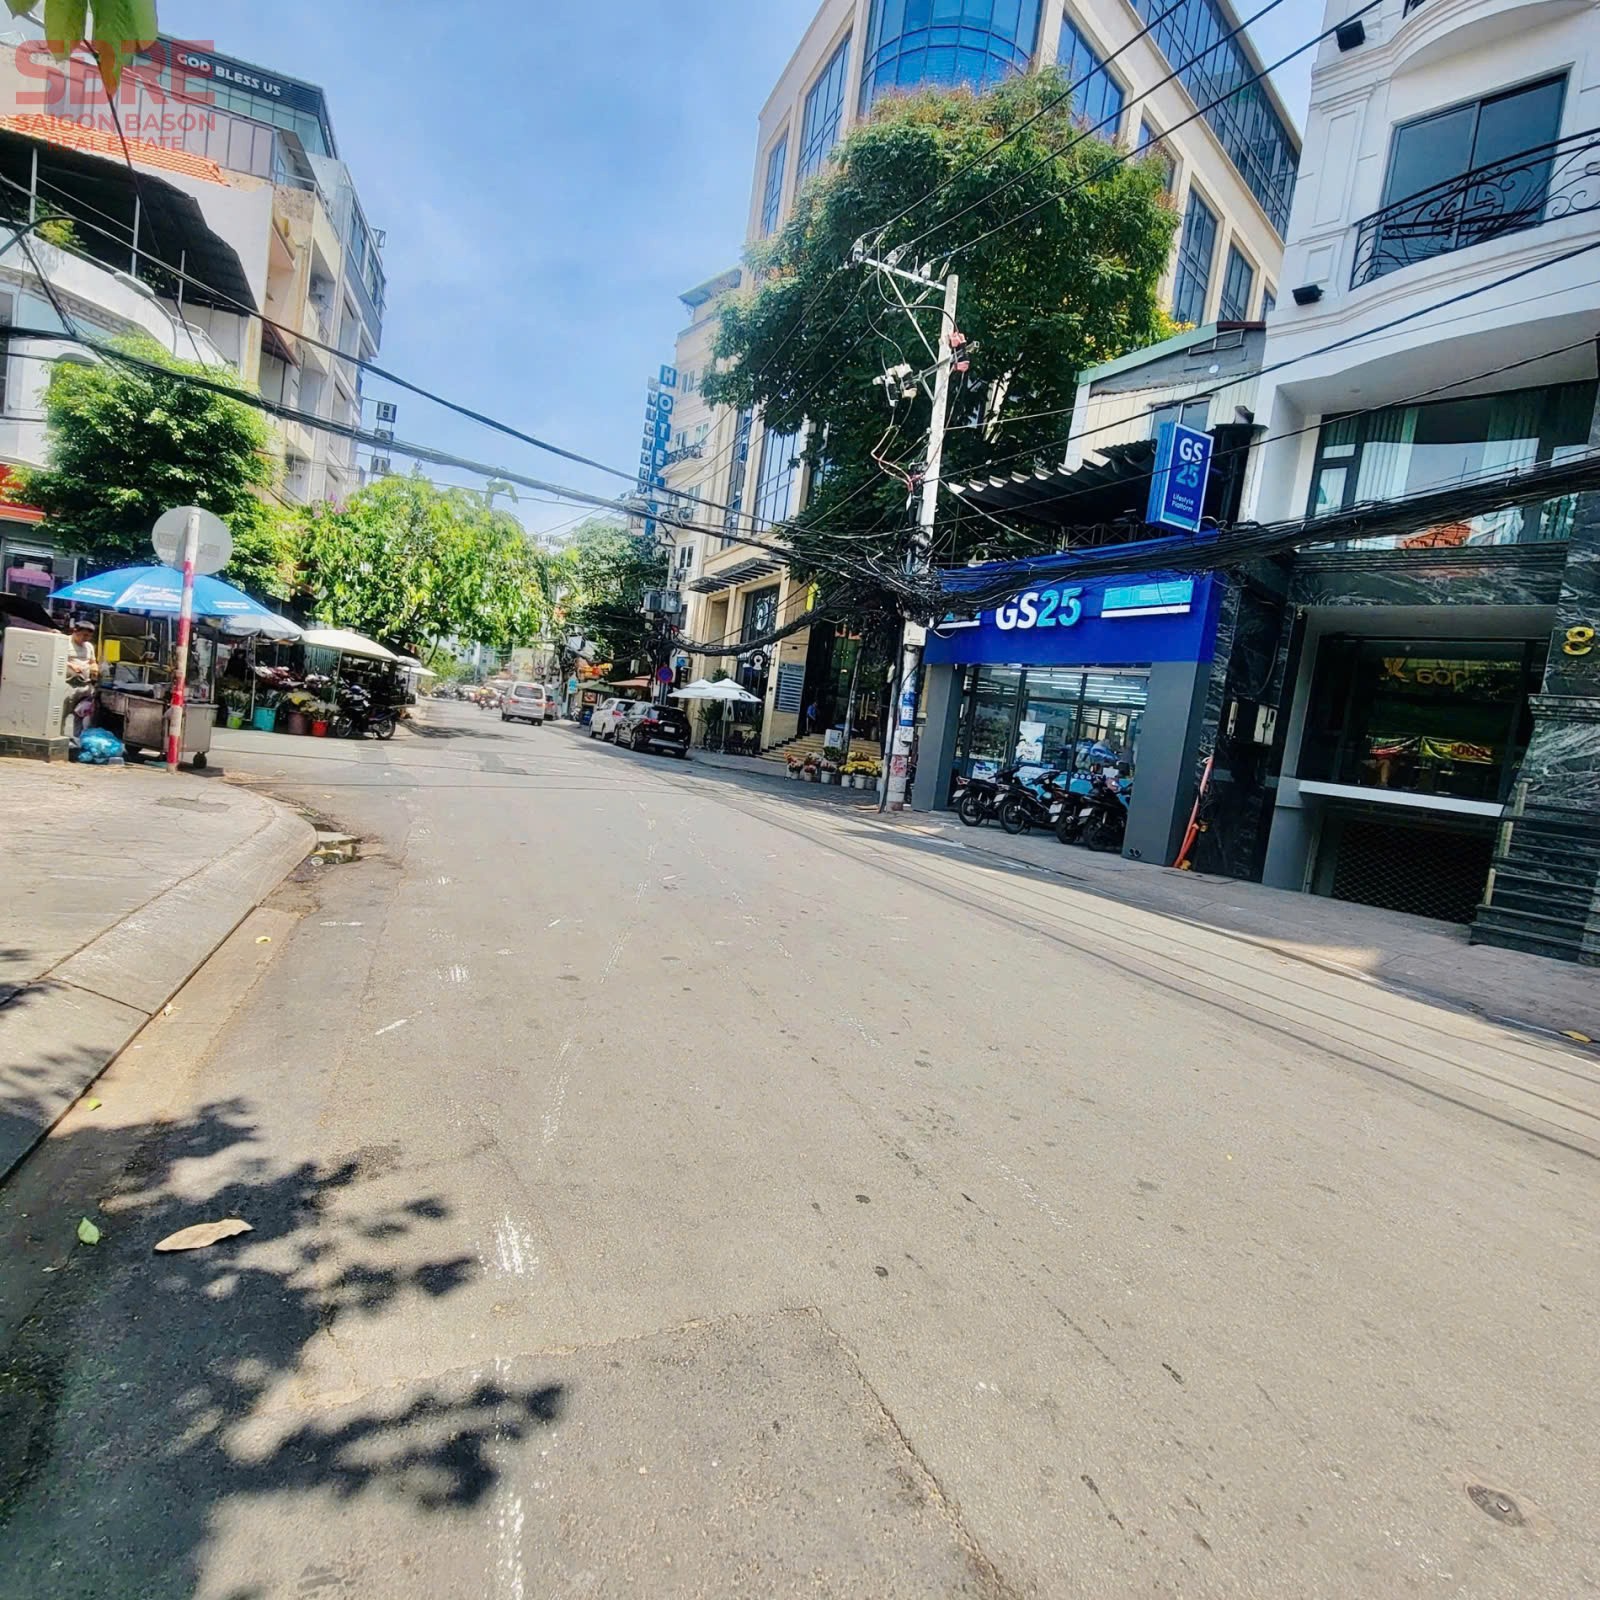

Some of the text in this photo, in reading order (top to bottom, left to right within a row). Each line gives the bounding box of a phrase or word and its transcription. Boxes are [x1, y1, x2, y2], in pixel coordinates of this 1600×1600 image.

[177, 53, 281, 96] GOD BLESS US
[1179, 438, 1204, 464] GS
[1176, 460, 1200, 488] 25
[1171, 500, 1194, 513] Platform
[1172, 493, 1194, 505] Lifestyle
[995, 586, 1083, 630] GS25
